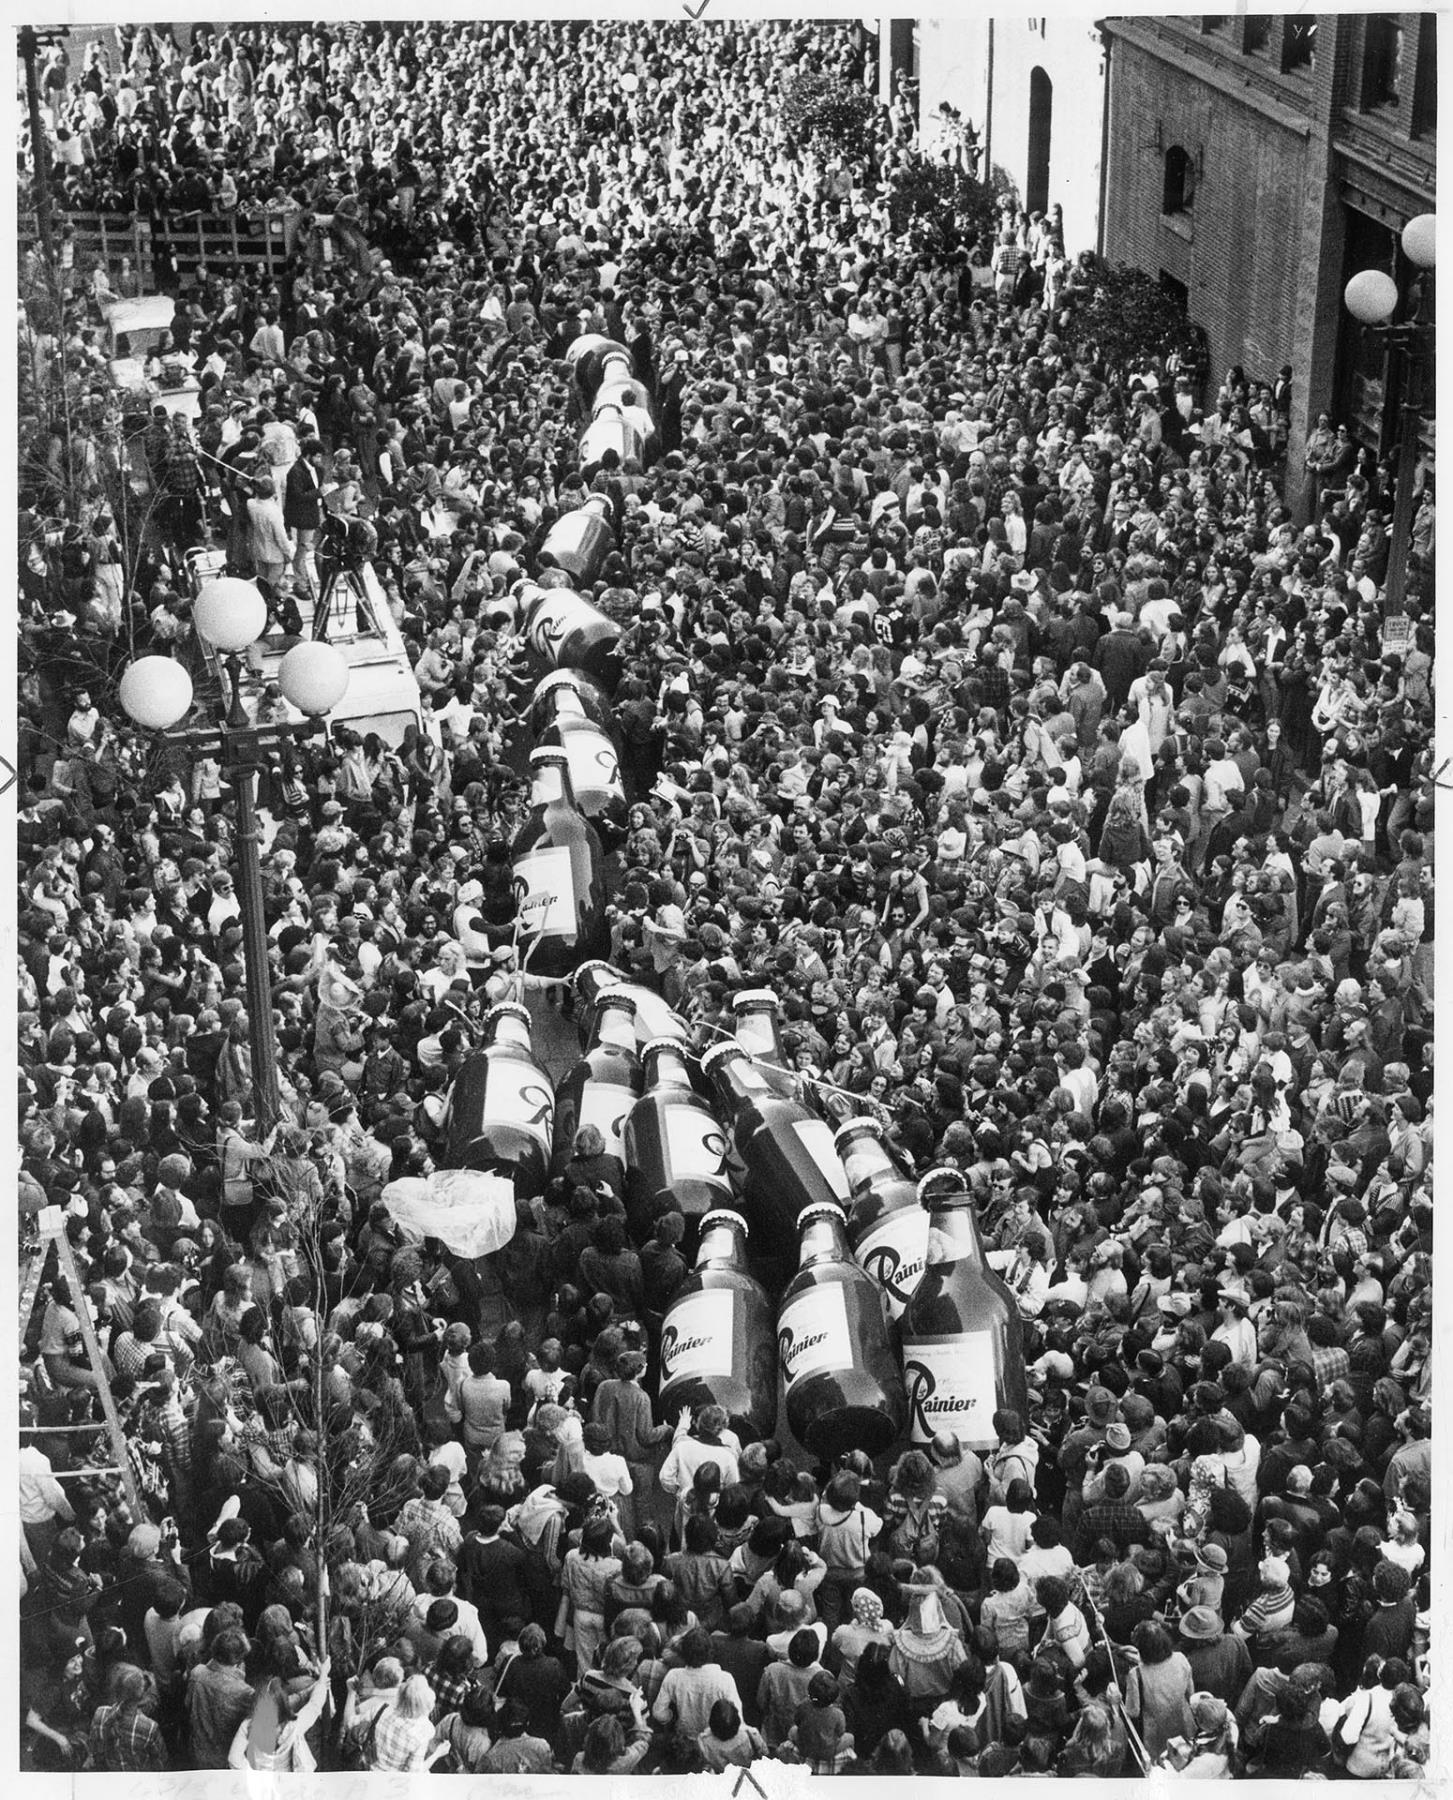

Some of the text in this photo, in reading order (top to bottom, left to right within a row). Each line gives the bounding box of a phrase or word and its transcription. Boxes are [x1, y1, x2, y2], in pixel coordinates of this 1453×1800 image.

[863, 1246, 924, 1312] Raini
[661, 1325, 713, 1381] Rainier
[778, 1327, 828, 1383] Rainier
[904, 1360, 976, 1438] Rainier
